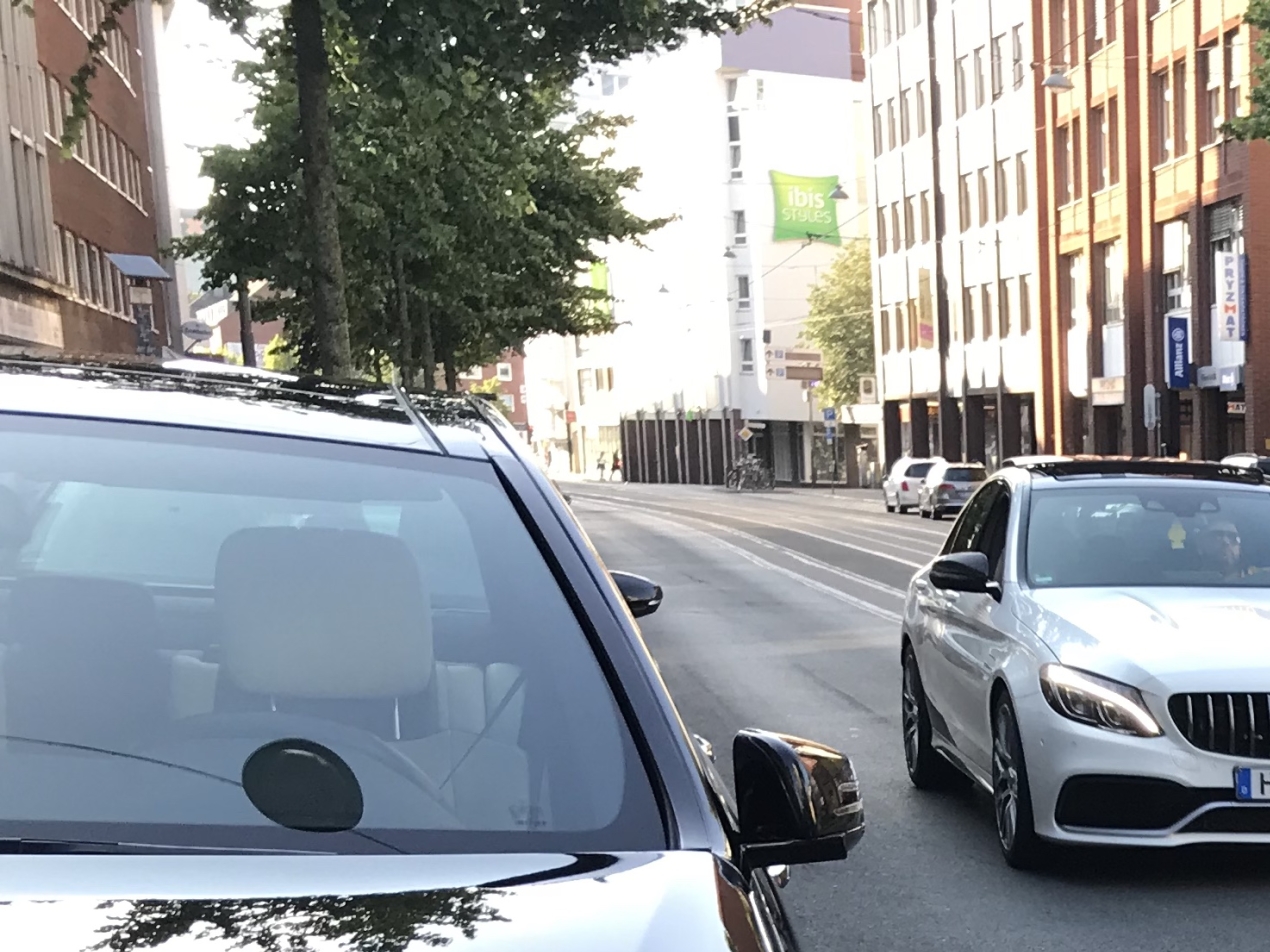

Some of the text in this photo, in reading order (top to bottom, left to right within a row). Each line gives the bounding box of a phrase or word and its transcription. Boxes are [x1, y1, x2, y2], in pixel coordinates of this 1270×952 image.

[788, 186, 825, 209] ibis
[1224, 256, 1236, 338] PRYZMAT
[1174, 343, 1184, 378] Allianz
